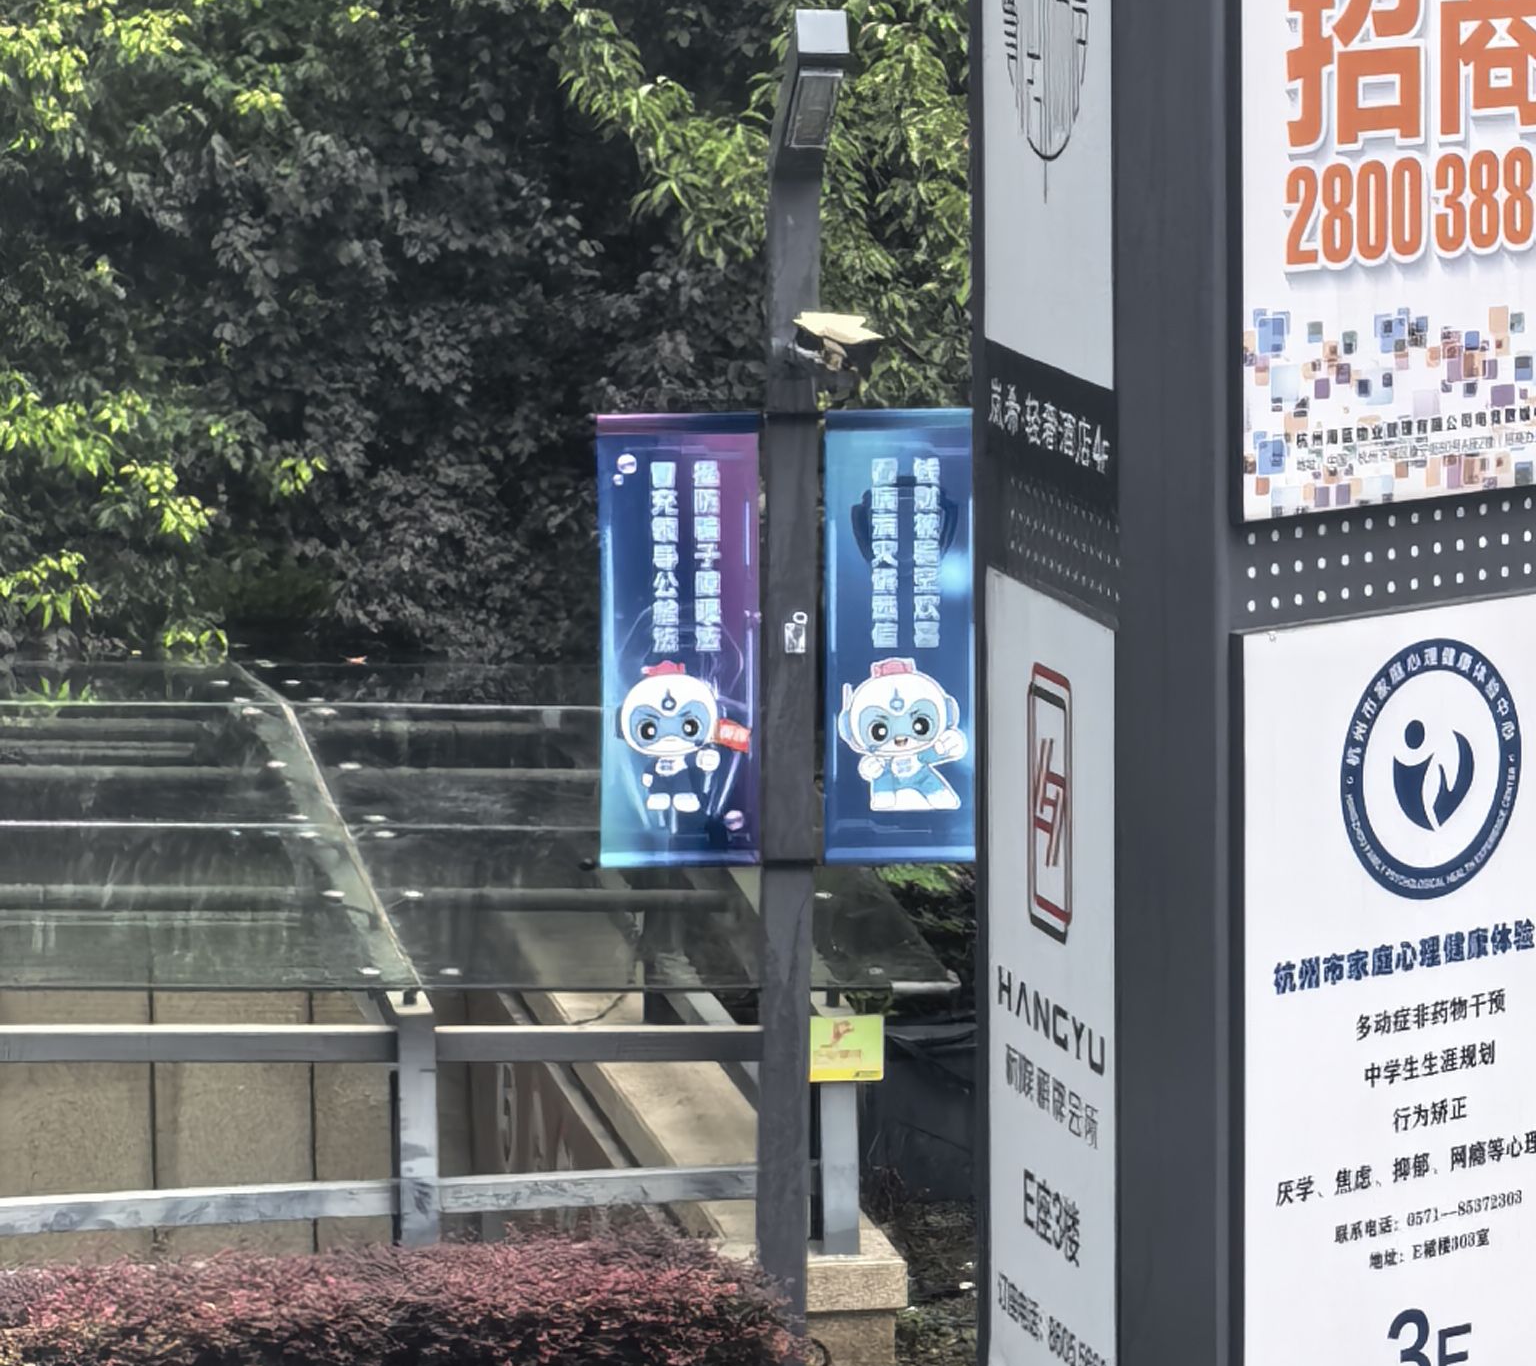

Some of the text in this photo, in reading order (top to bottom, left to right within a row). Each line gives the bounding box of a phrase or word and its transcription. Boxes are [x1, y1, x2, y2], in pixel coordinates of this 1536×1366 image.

[1285, 156, 1423, 266] 2800
[1355, 988, 1506, 1042] 多动症非药物干预
[1364, 1040, 1496, 1088] 中学生生涯规划
[1392, 1096, 1468, 1133] 行为矫正
